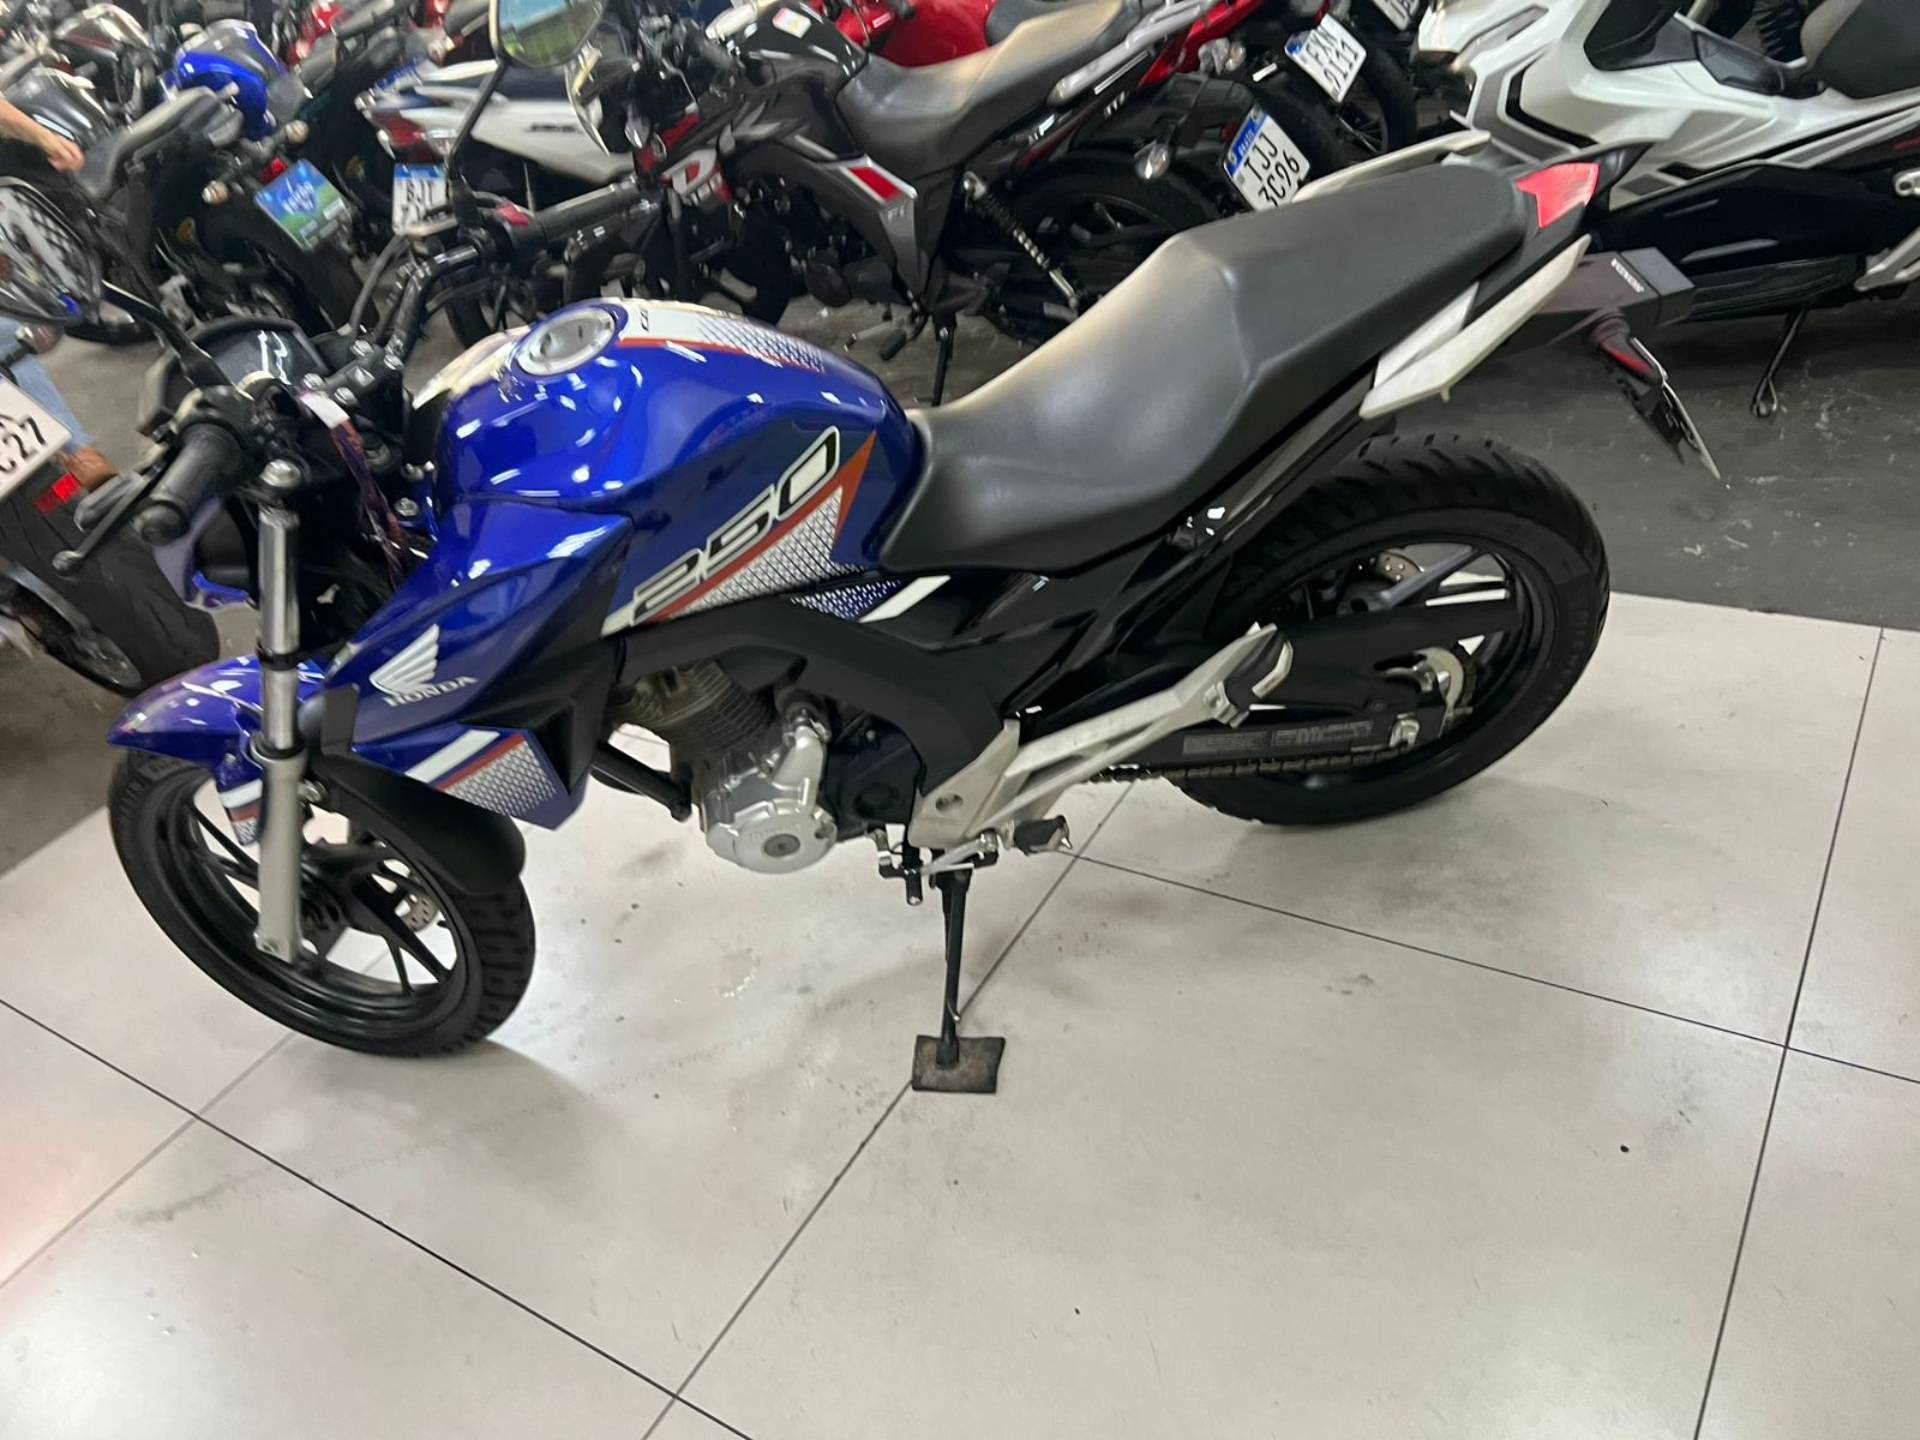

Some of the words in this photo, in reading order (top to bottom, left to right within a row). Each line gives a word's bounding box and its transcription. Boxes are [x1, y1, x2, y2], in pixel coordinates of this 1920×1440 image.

[1244, 132, 1278, 182] TJJ
[631, 425, 841, 627] 250
[382, 676, 479, 707] HONDA
